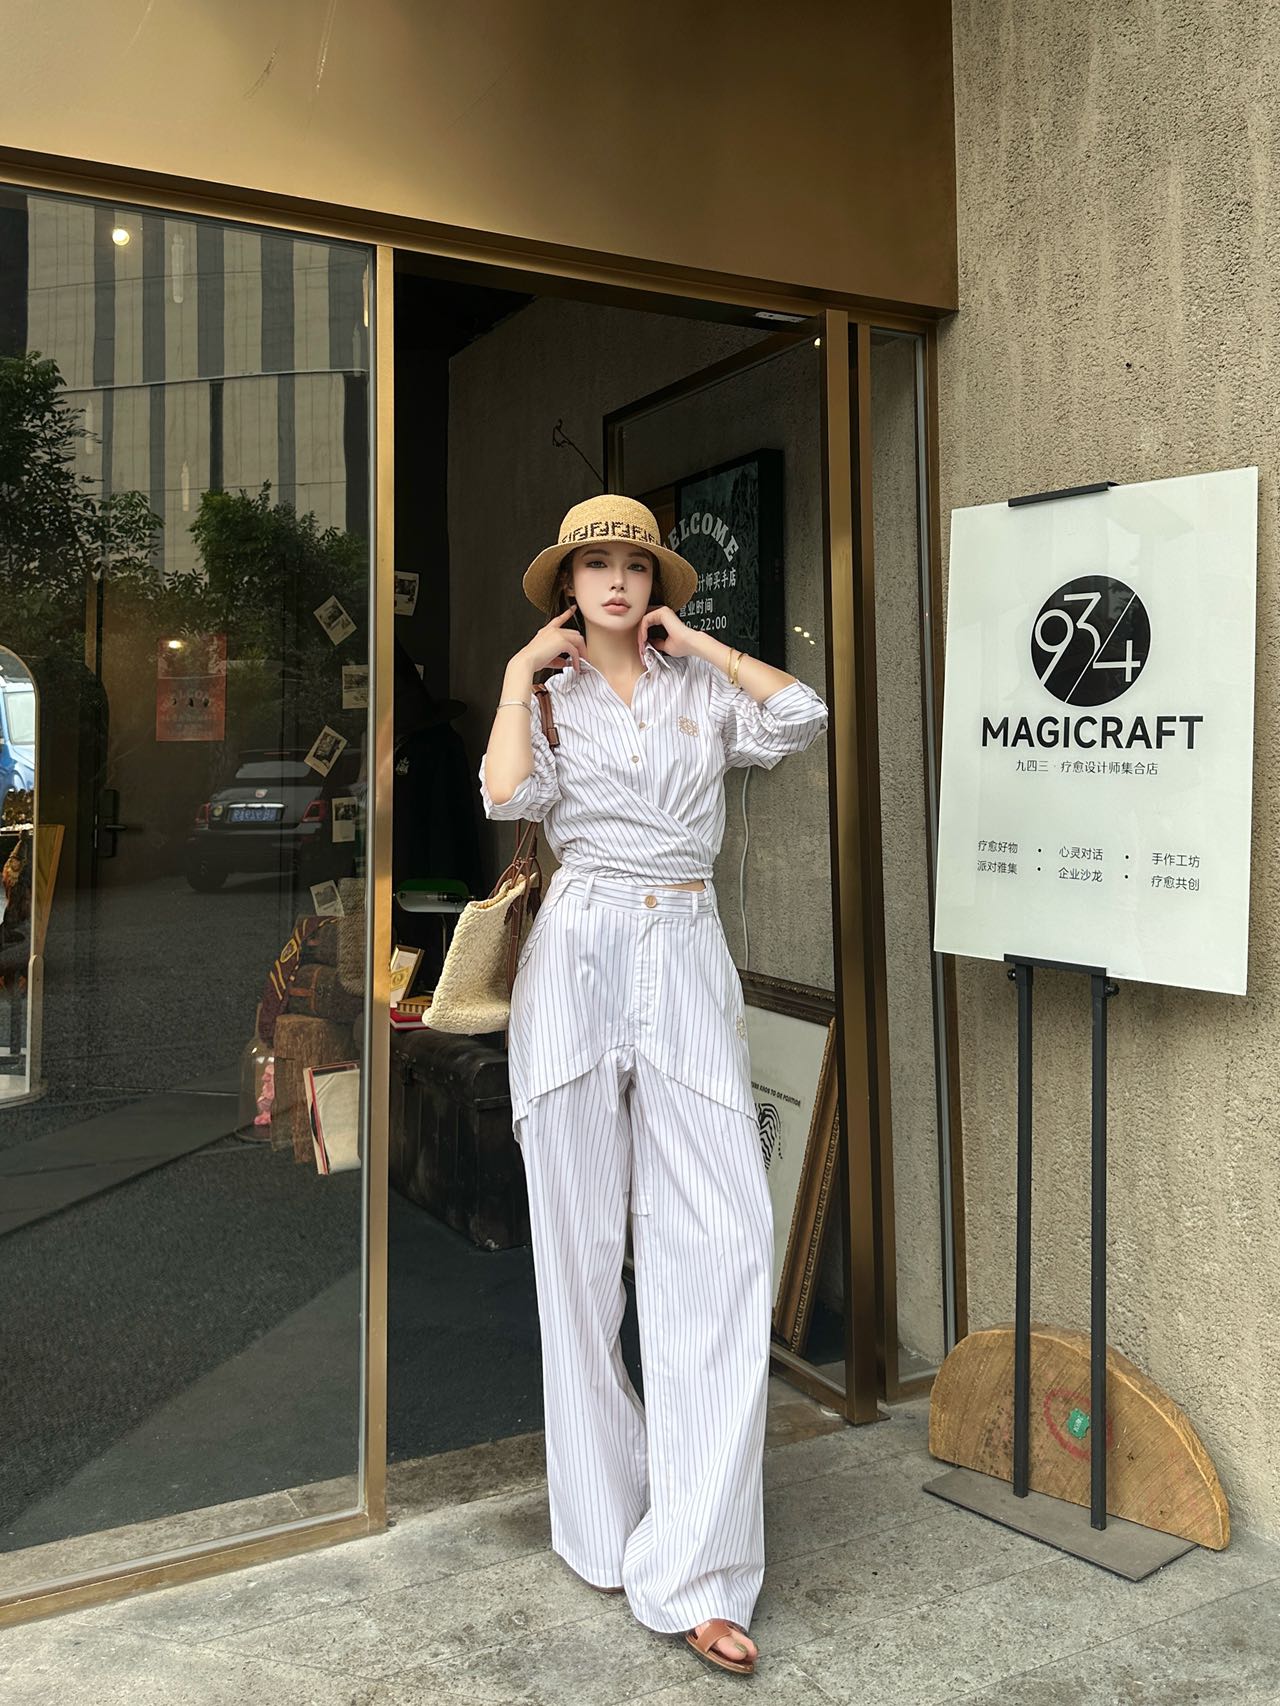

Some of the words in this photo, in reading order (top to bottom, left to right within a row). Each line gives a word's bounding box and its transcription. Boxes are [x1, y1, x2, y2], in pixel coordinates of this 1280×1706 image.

[664, 512, 740, 563] ELCOME
[695, 567, 737, 593] 计师买手店
[981, 715, 1204, 750] MAGICRAFT
[977, 840, 1019, 854] 疗愈好物
[1058, 846, 1104, 861] 心灵对话
[1151, 853, 1201, 868] 手作工坊
[976, 860, 1018, 875] 派对雅集
[1058, 867, 1103, 882] 企业沙龙
[1151, 875, 1201, 891] 疗愈共创
